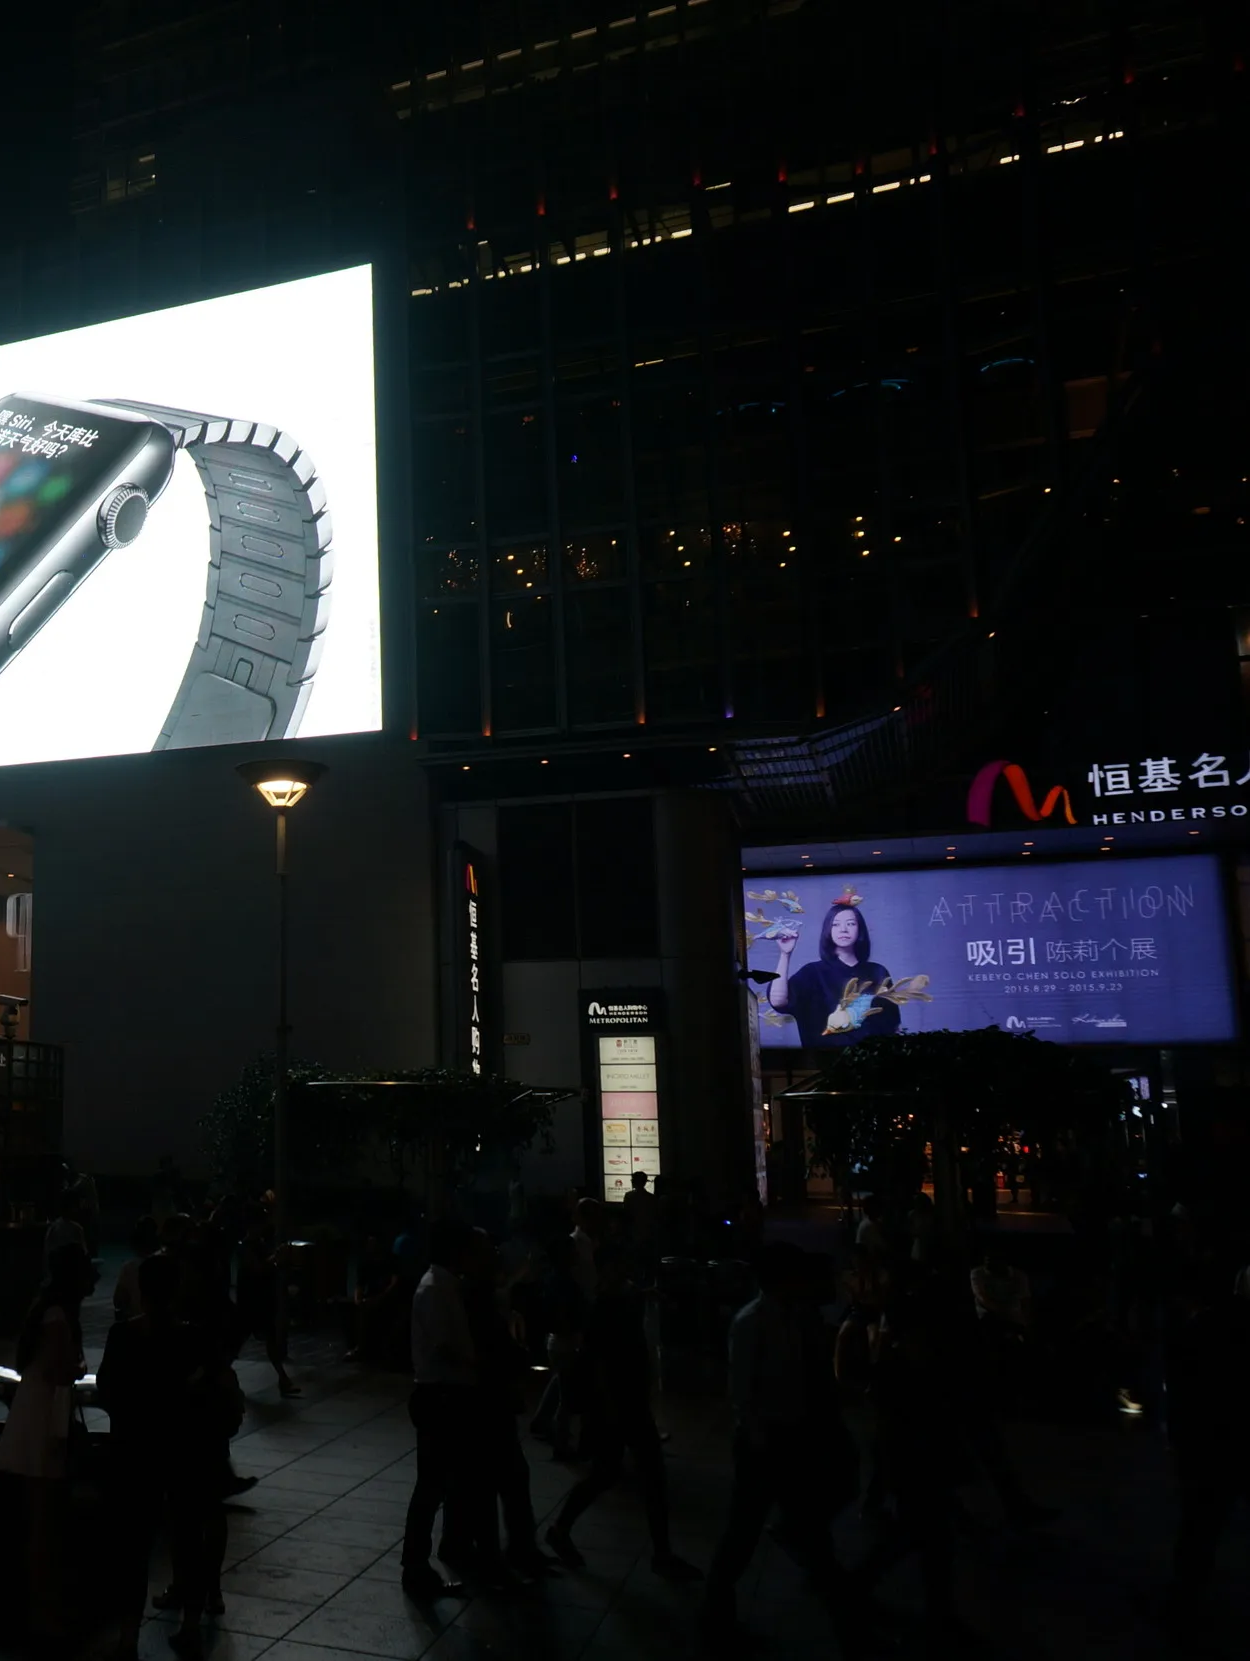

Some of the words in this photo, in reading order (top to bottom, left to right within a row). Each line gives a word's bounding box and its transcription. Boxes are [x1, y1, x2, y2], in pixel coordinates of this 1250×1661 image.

[1092, 804, 1248, 825] HENDERSO
[1045, 937, 1158, 963] 陈莉个展
[1016, 972, 1049, 981] CHEN
[1053, 971, 1086, 980] SOLO
[1090, 968, 1160, 978] EXHIBITION
